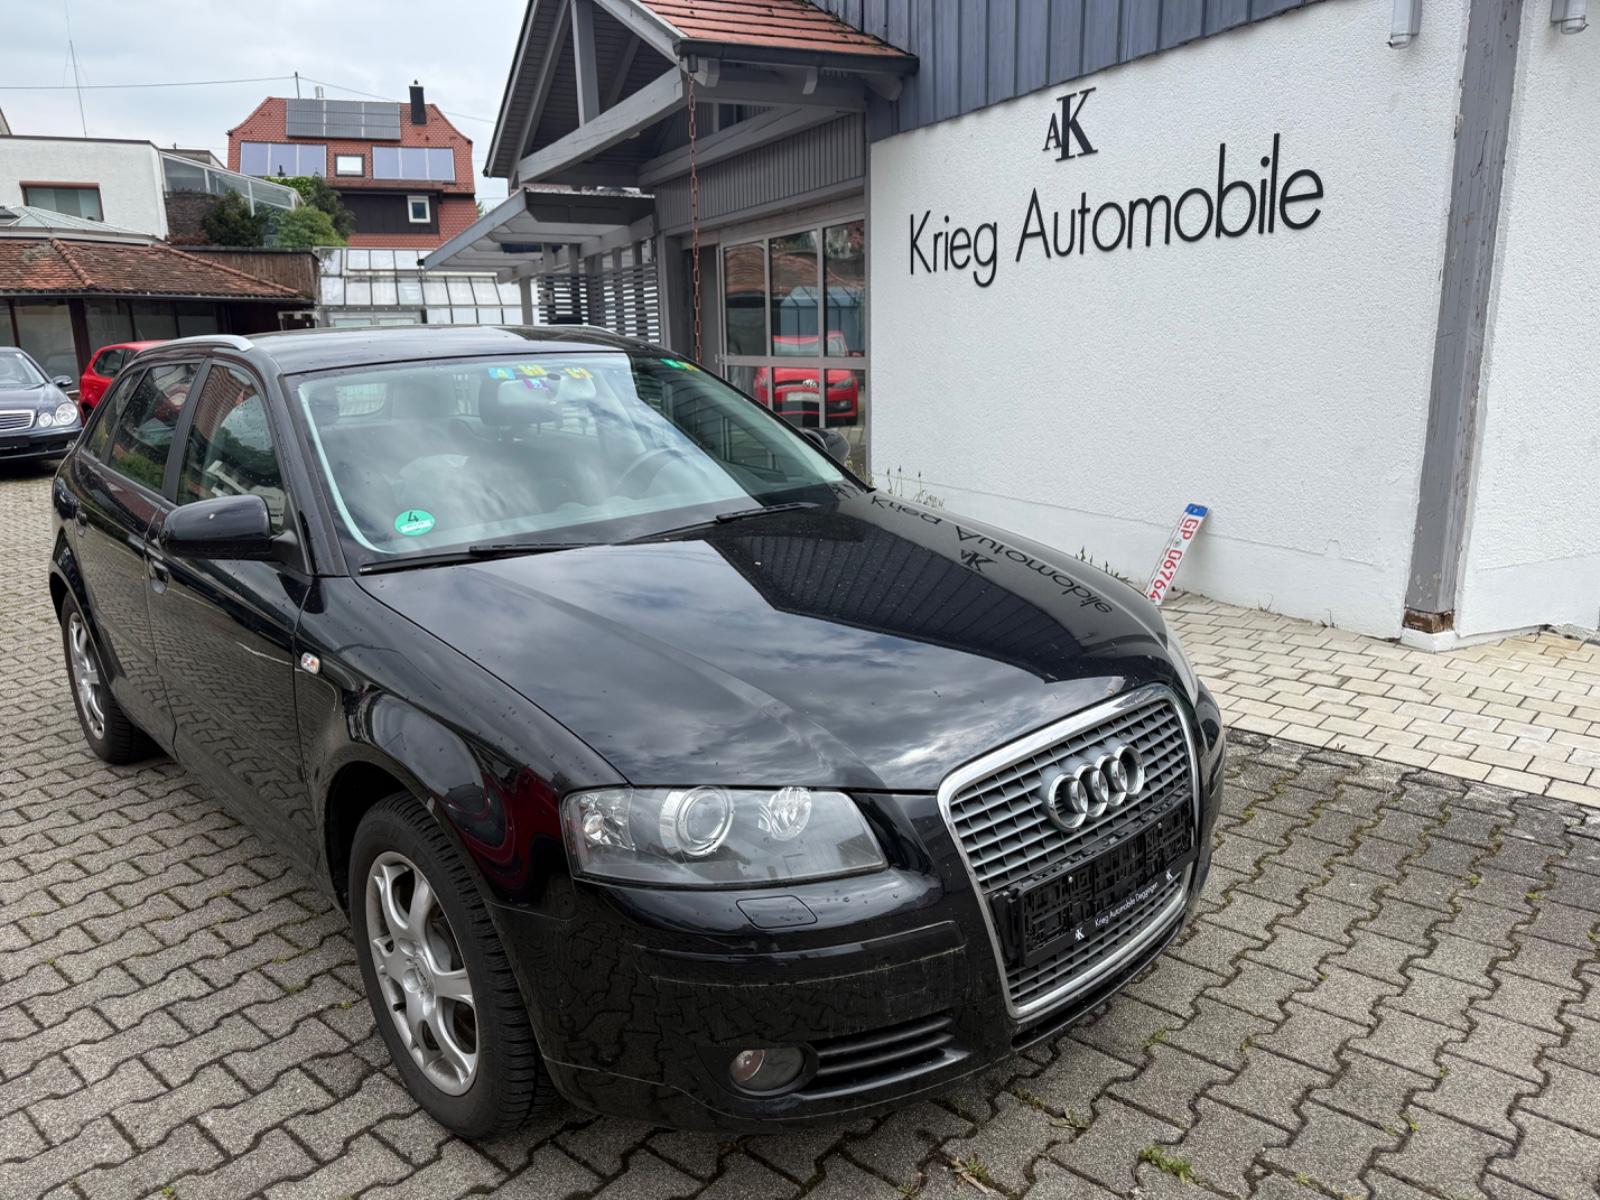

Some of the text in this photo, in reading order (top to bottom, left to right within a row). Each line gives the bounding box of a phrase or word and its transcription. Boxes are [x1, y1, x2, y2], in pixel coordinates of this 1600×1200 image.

[909, 132, 1324, 288] Krieg Automobile
[407, 511, 420, 523] 4
[1180, 518, 1200, 540] GP
[1095, 915, 1109, 928] Krieg
